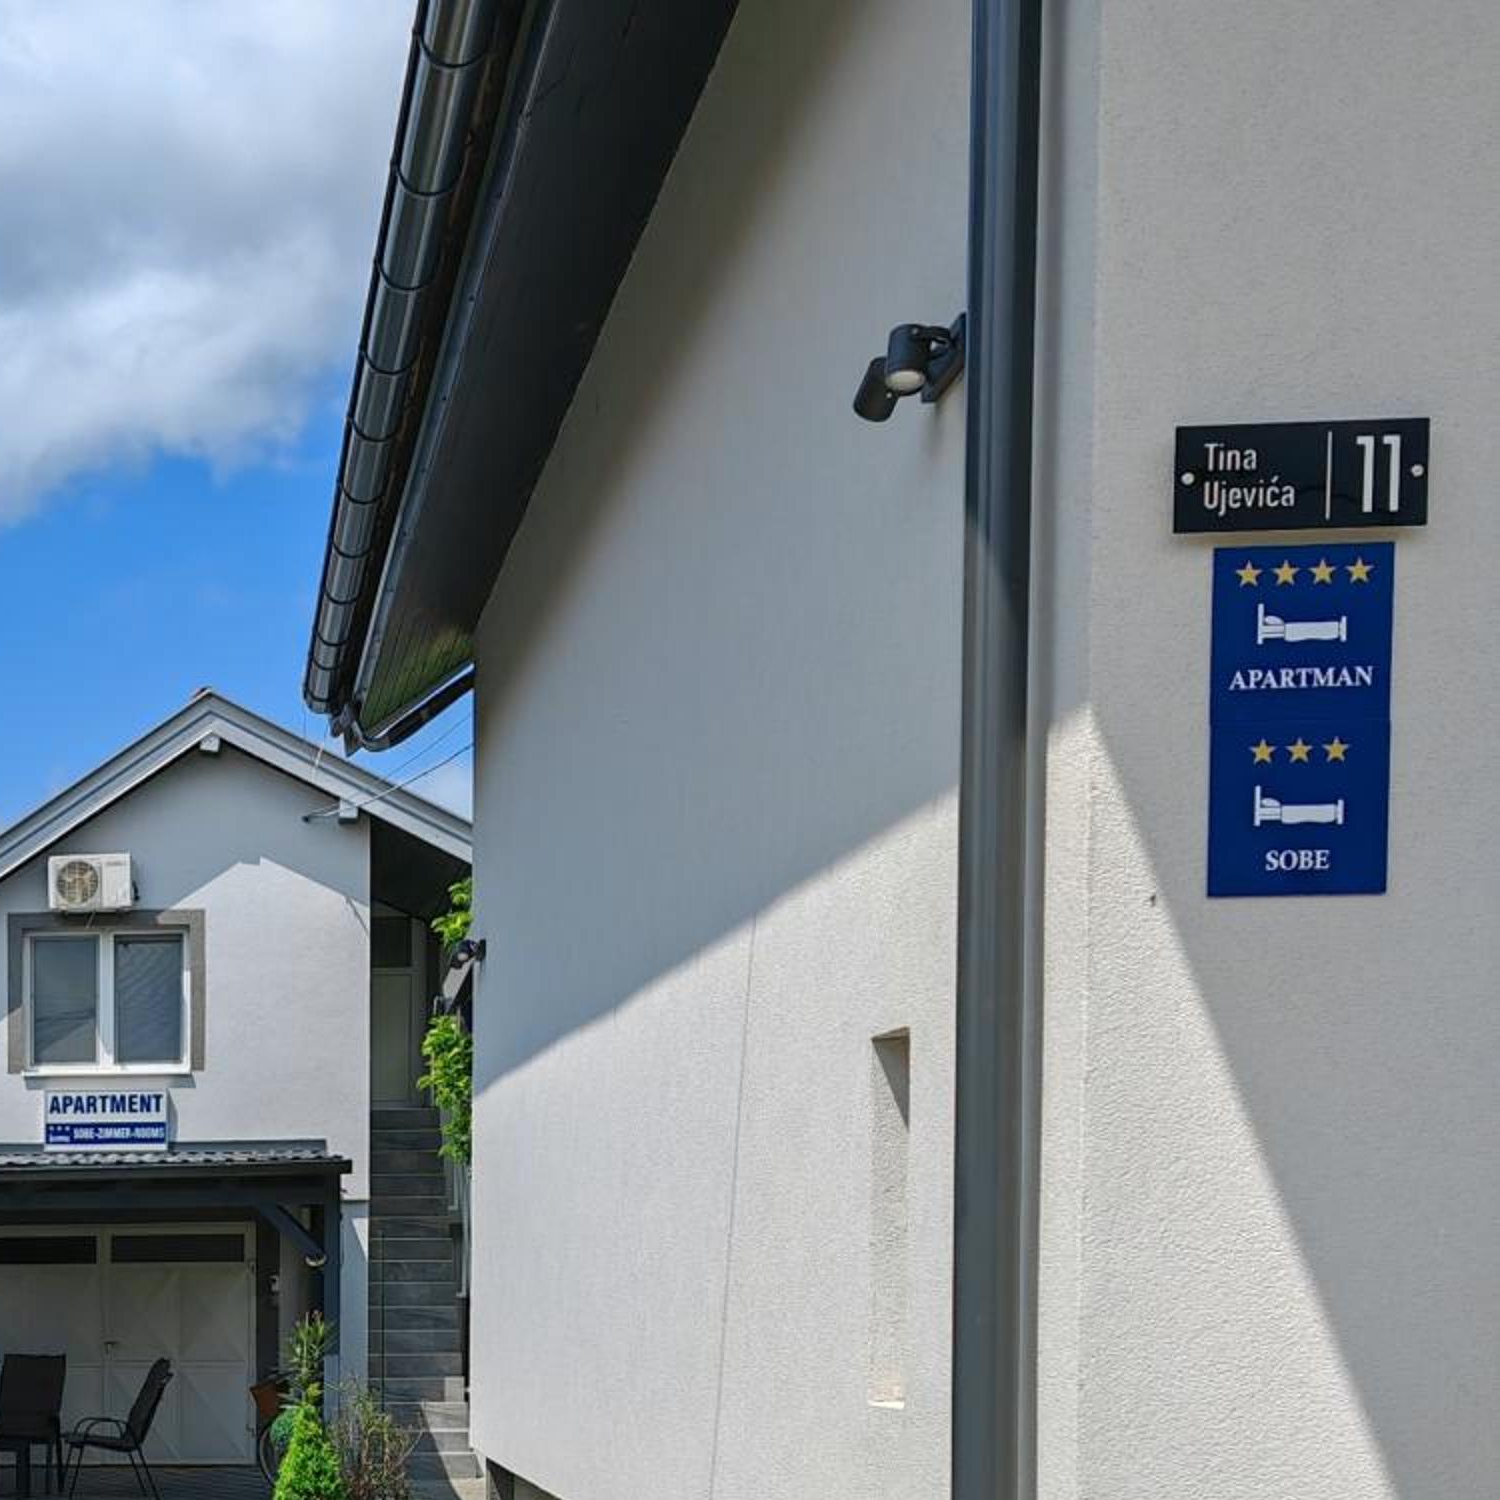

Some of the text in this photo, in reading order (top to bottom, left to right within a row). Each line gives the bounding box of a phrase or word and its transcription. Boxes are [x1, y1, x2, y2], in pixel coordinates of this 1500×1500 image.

[1204, 443, 1257, 471] Tina
[1357, 435, 1401, 513] 11
[1204, 475, 1295, 517] Ujevića
[1229, 666, 1373, 690] APARTMAN
[1265, 850, 1330, 871] SOBE
[49, 1094, 163, 1114] APARTMENT
